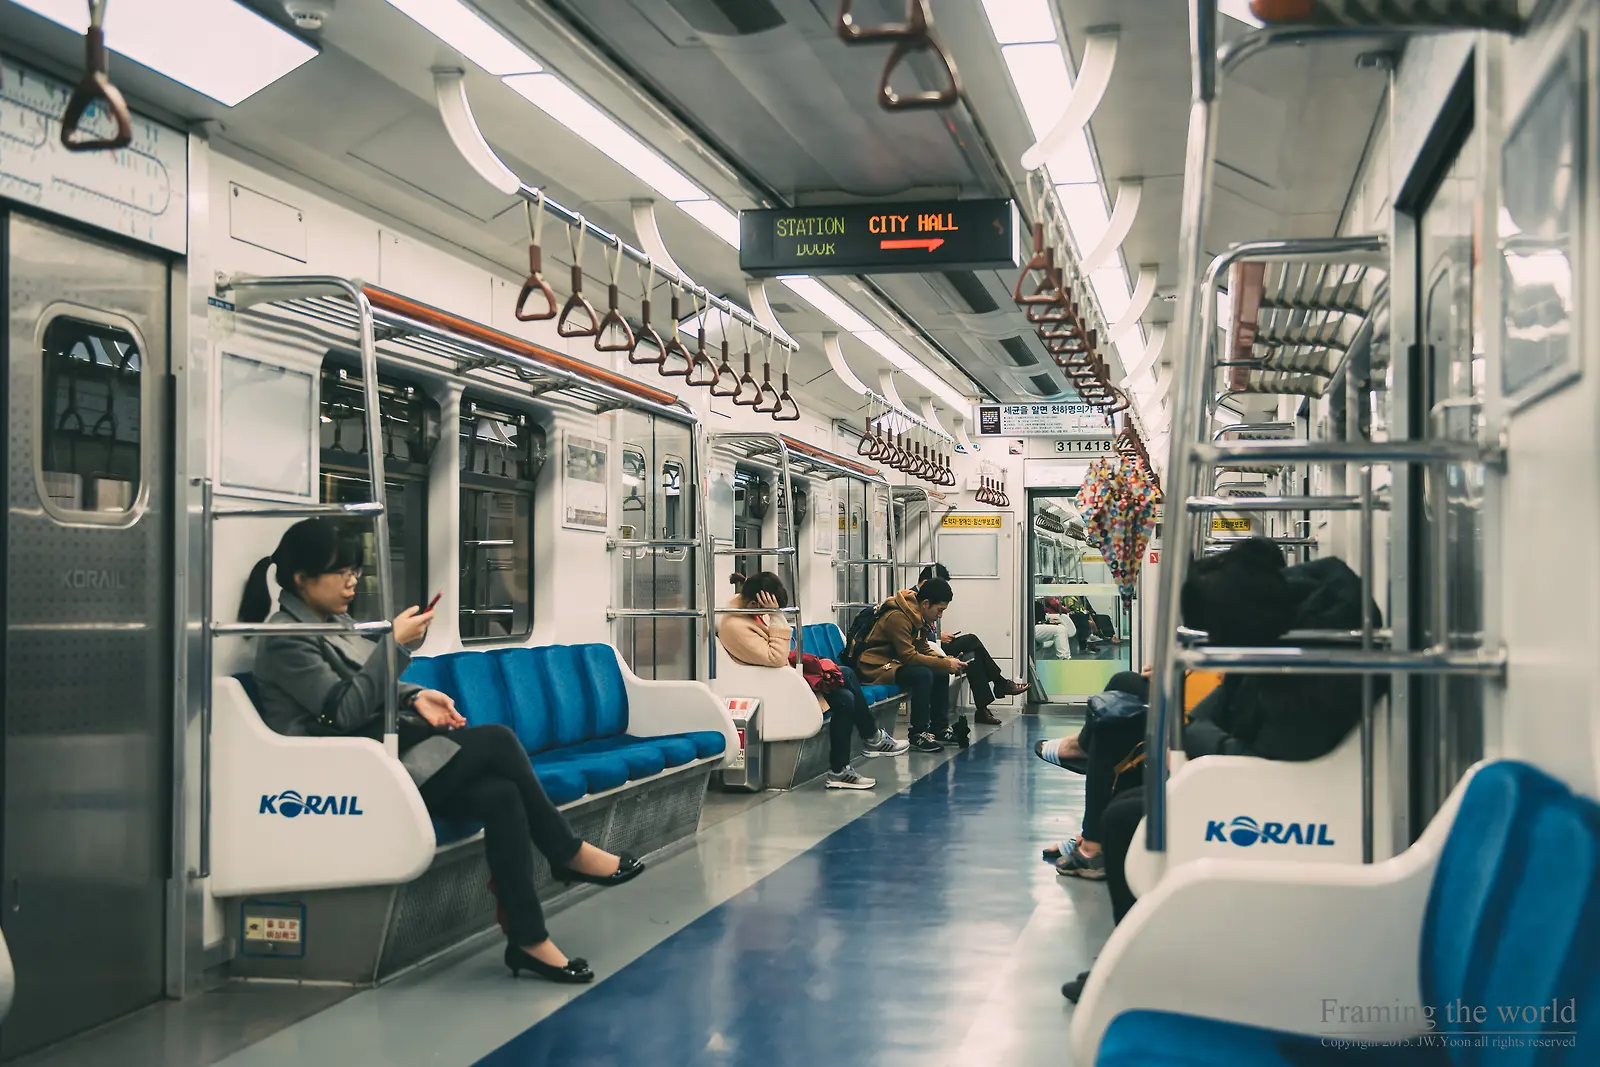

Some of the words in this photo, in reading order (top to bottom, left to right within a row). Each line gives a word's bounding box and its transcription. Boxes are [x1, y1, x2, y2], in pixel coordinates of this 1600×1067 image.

[776, 217, 845, 237] STATION
[868, 215, 909, 234] CITY
[917, 213, 959, 232] HALL
[1003, 405, 1028, 415] 세균을
[1031, 405, 1048, 415] 알면
[1051, 405, 1093, 415] 천하명의가
[1056, 440, 1111, 452] 311418
[61, 568, 125, 589] KORAIL
[259, 790, 363, 818] KORAIL
[1204, 815, 1335, 847] KORAIL
